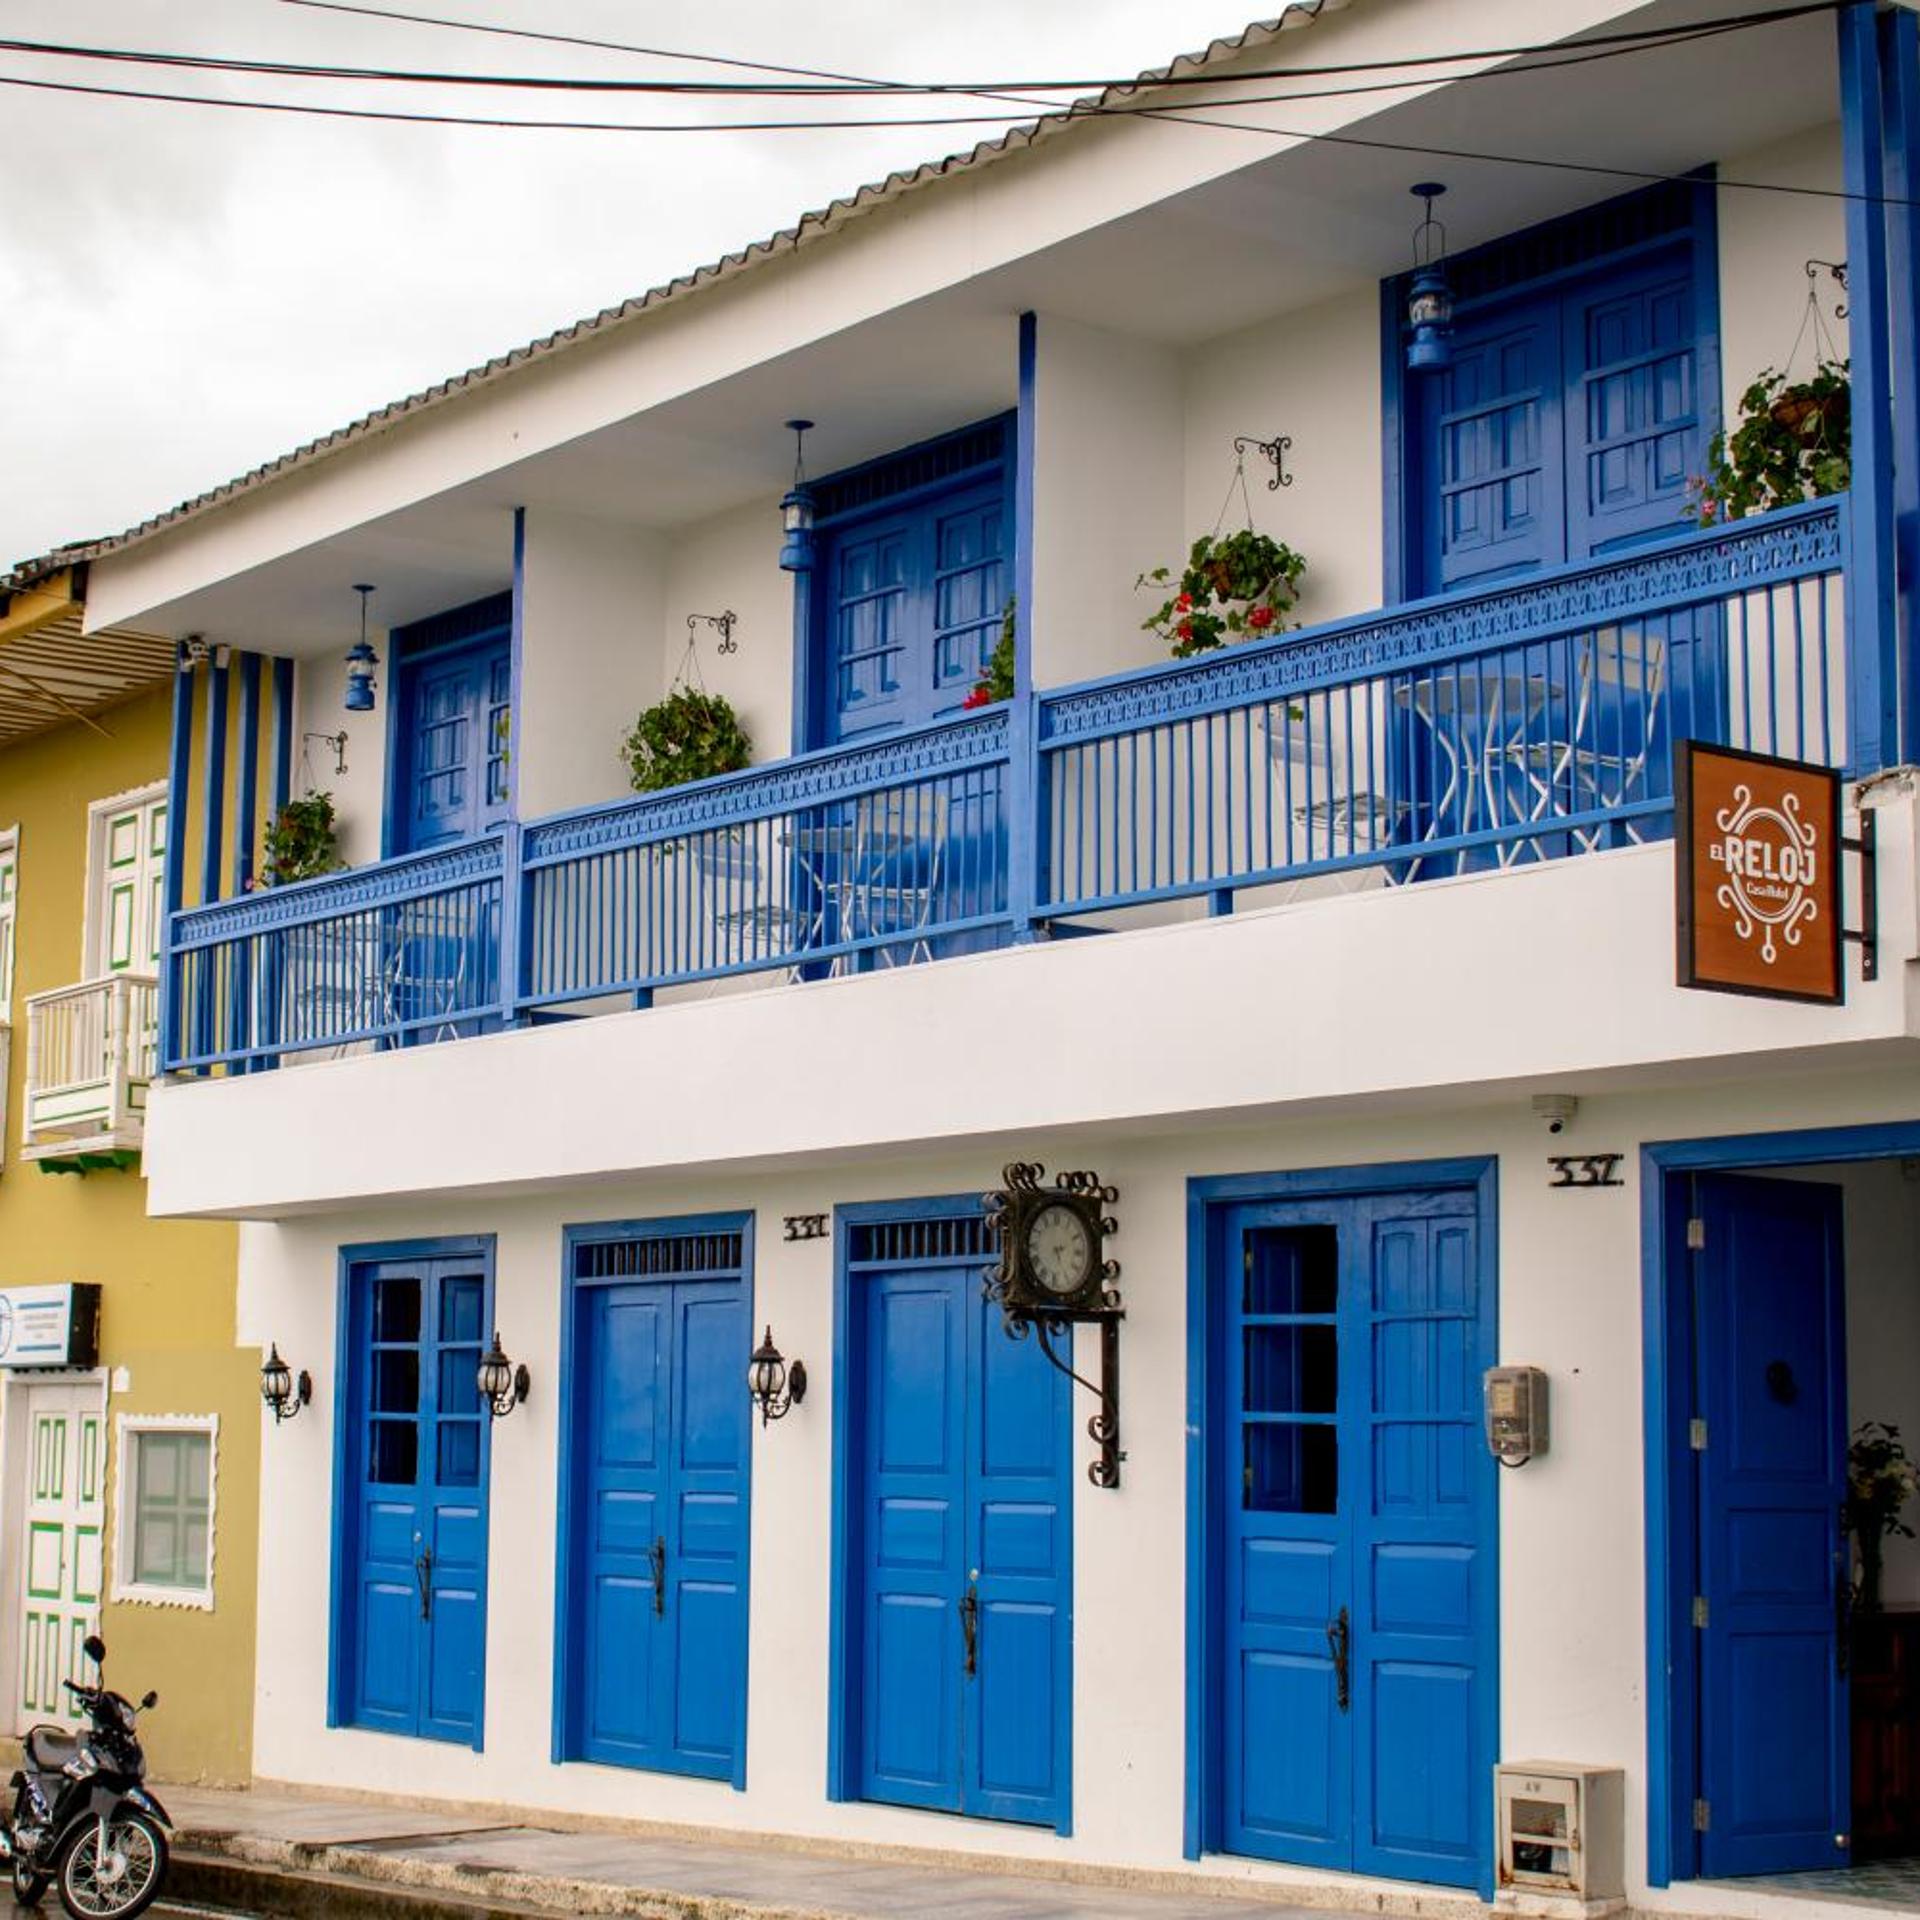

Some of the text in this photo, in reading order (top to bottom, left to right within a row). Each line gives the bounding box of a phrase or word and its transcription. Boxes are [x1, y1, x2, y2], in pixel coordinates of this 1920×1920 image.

[1710, 836, 1815, 886] EL RELOJ
[1547, 1154, 1624, 1187] 337
